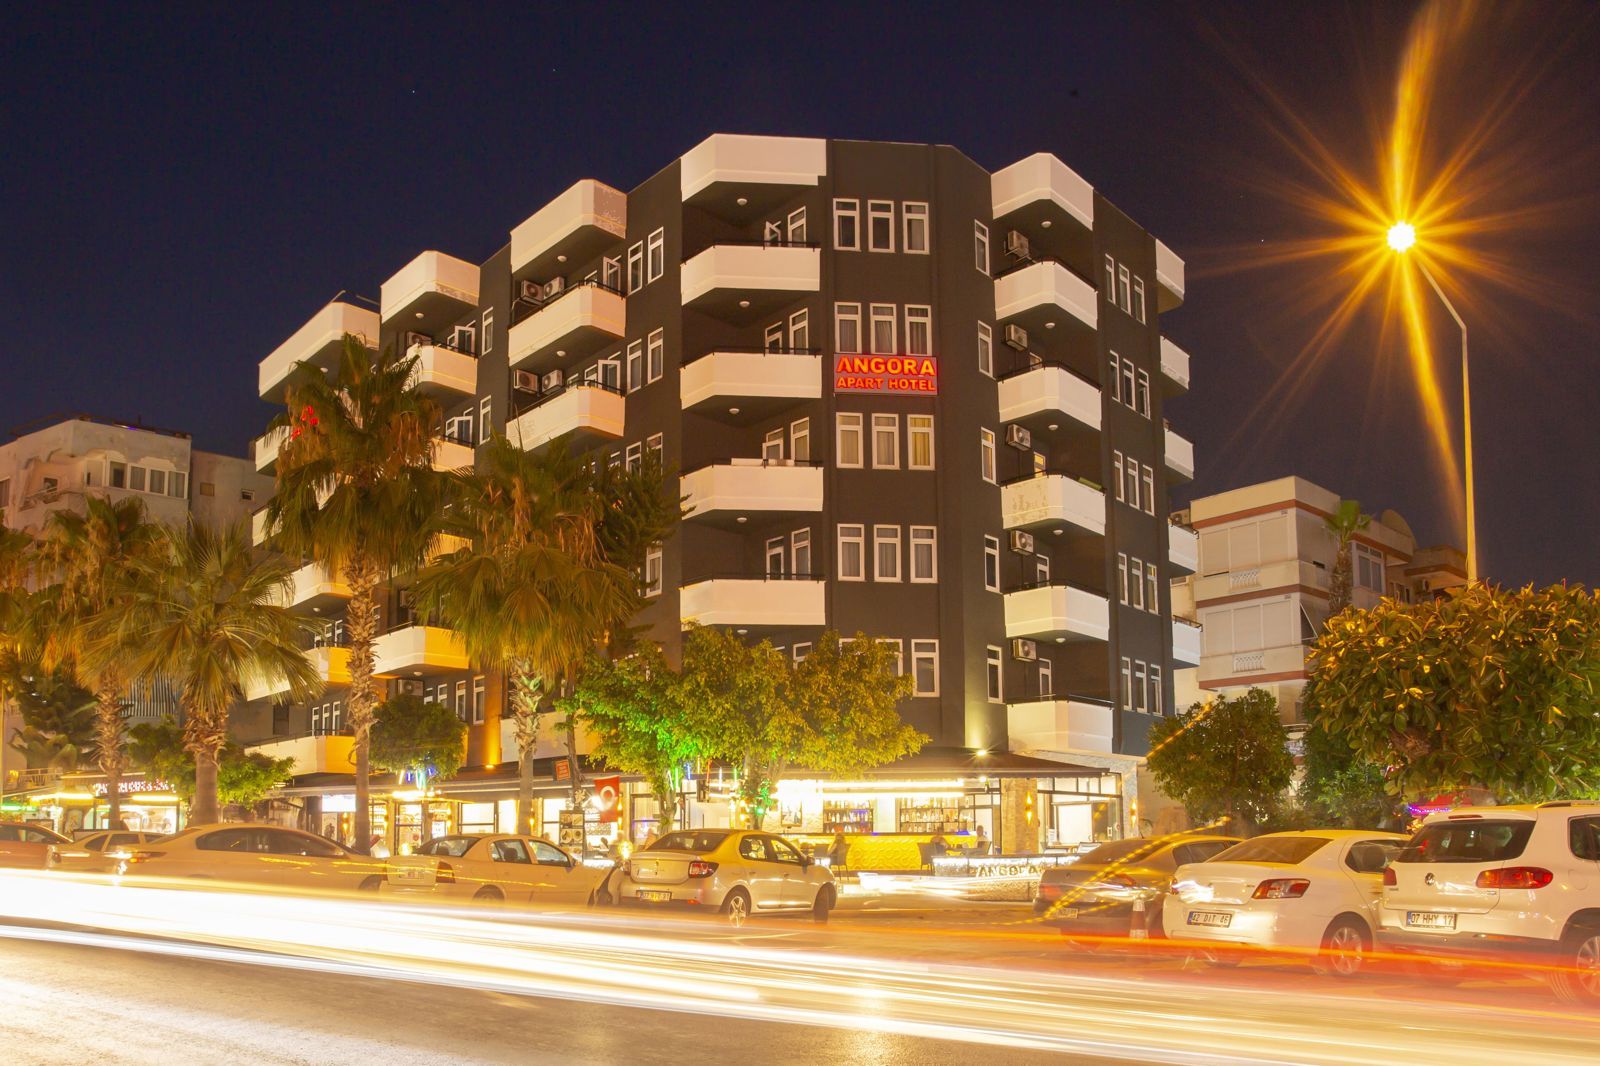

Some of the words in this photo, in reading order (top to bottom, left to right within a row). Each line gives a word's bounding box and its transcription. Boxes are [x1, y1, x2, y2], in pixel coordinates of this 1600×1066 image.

[836, 355, 936, 376] ANGORA
[837, 377, 884, 389] APART
[888, 378, 936, 391] HOTEL
